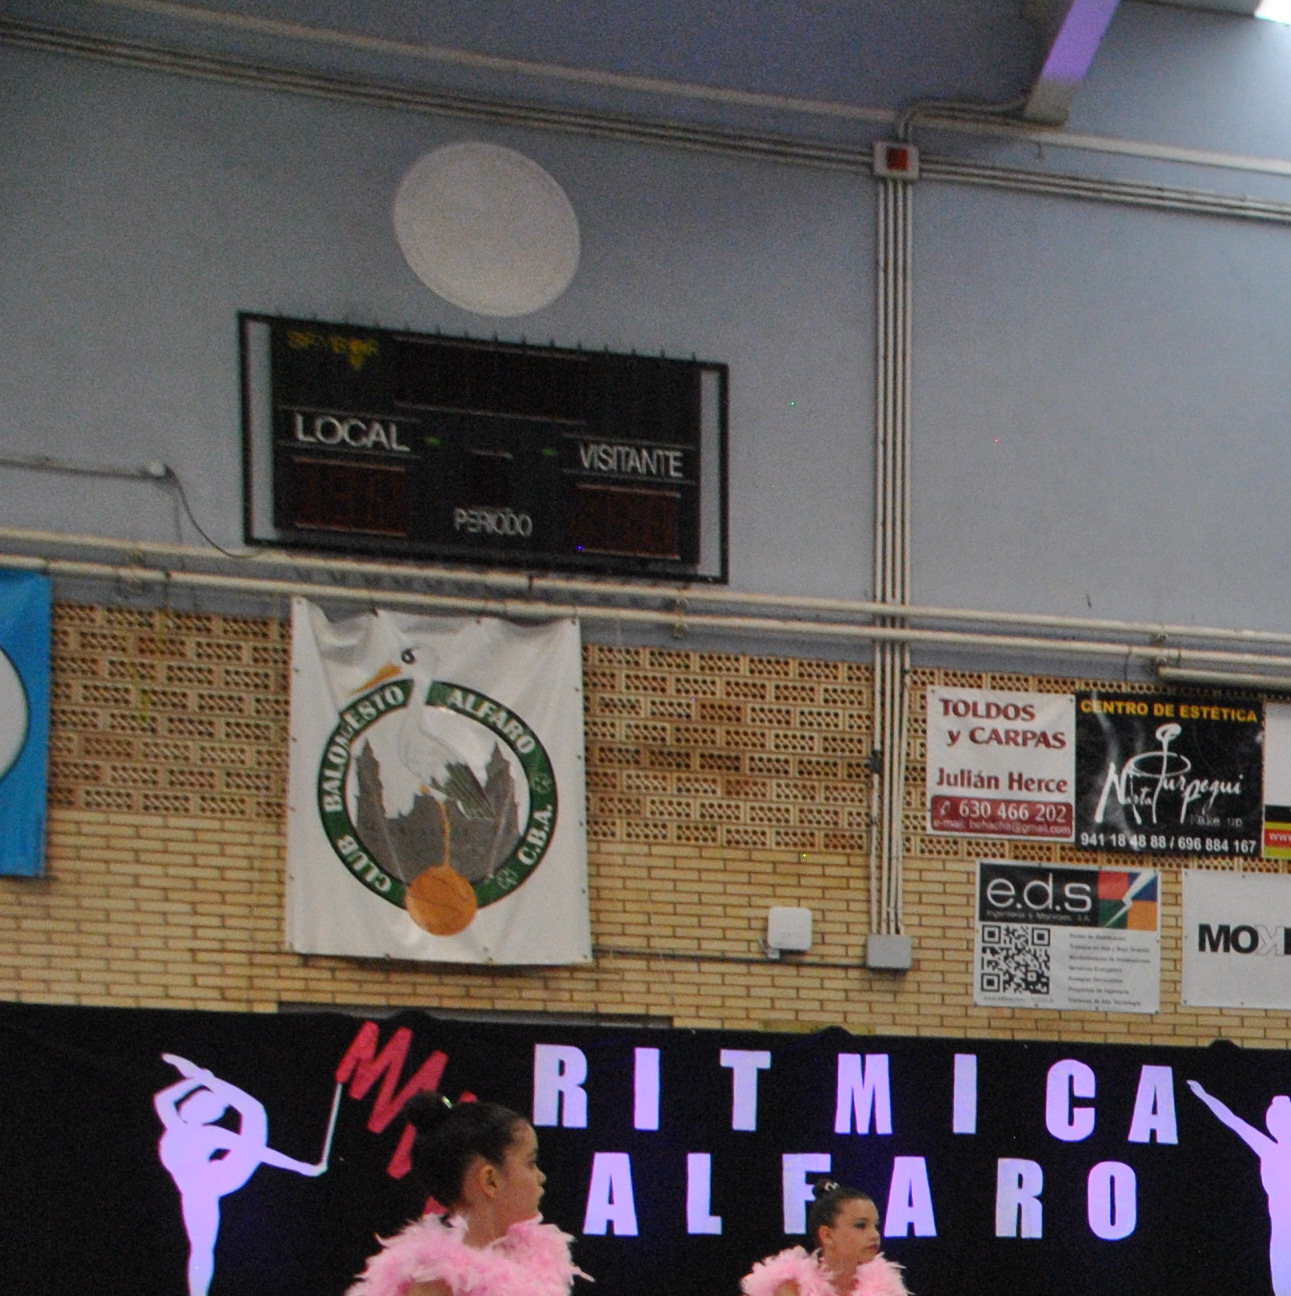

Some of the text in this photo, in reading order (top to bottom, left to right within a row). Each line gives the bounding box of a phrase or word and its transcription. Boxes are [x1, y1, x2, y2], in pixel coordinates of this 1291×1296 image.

[294, 412, 410, 452] LOCAL
[580, 443, 684, 478] VISITANTE
[453, 507, 533, 537] PERIODO
[939, 698, 1036, 721] TOLDOS
[1081, 700, 1148, 715] CENTRO
[1154, 703, 1174, 717] DE
[947, 727, 1066, 749] y CARPAS
[336, 835, 392, 893] CLUB
[448, 689, 536, 755] ALFARO
[937, 767, 1068, 793] Julián Herce
[959, 800, 1066, 822] 630 466 202
[1081, 833, 1105, 846] 941
[1111, 833, 1124, 847] 18
[1150, 835, 1167, 849] 88
[1178, 837, 1201, 850] 696
[1206, 838, 1229, 851] 884
[1234, 840, 1256, 853] 167
[532, 1043, 1179, 1146] RITMICA
[583, 1152, 1138, 1241] ALFARO
